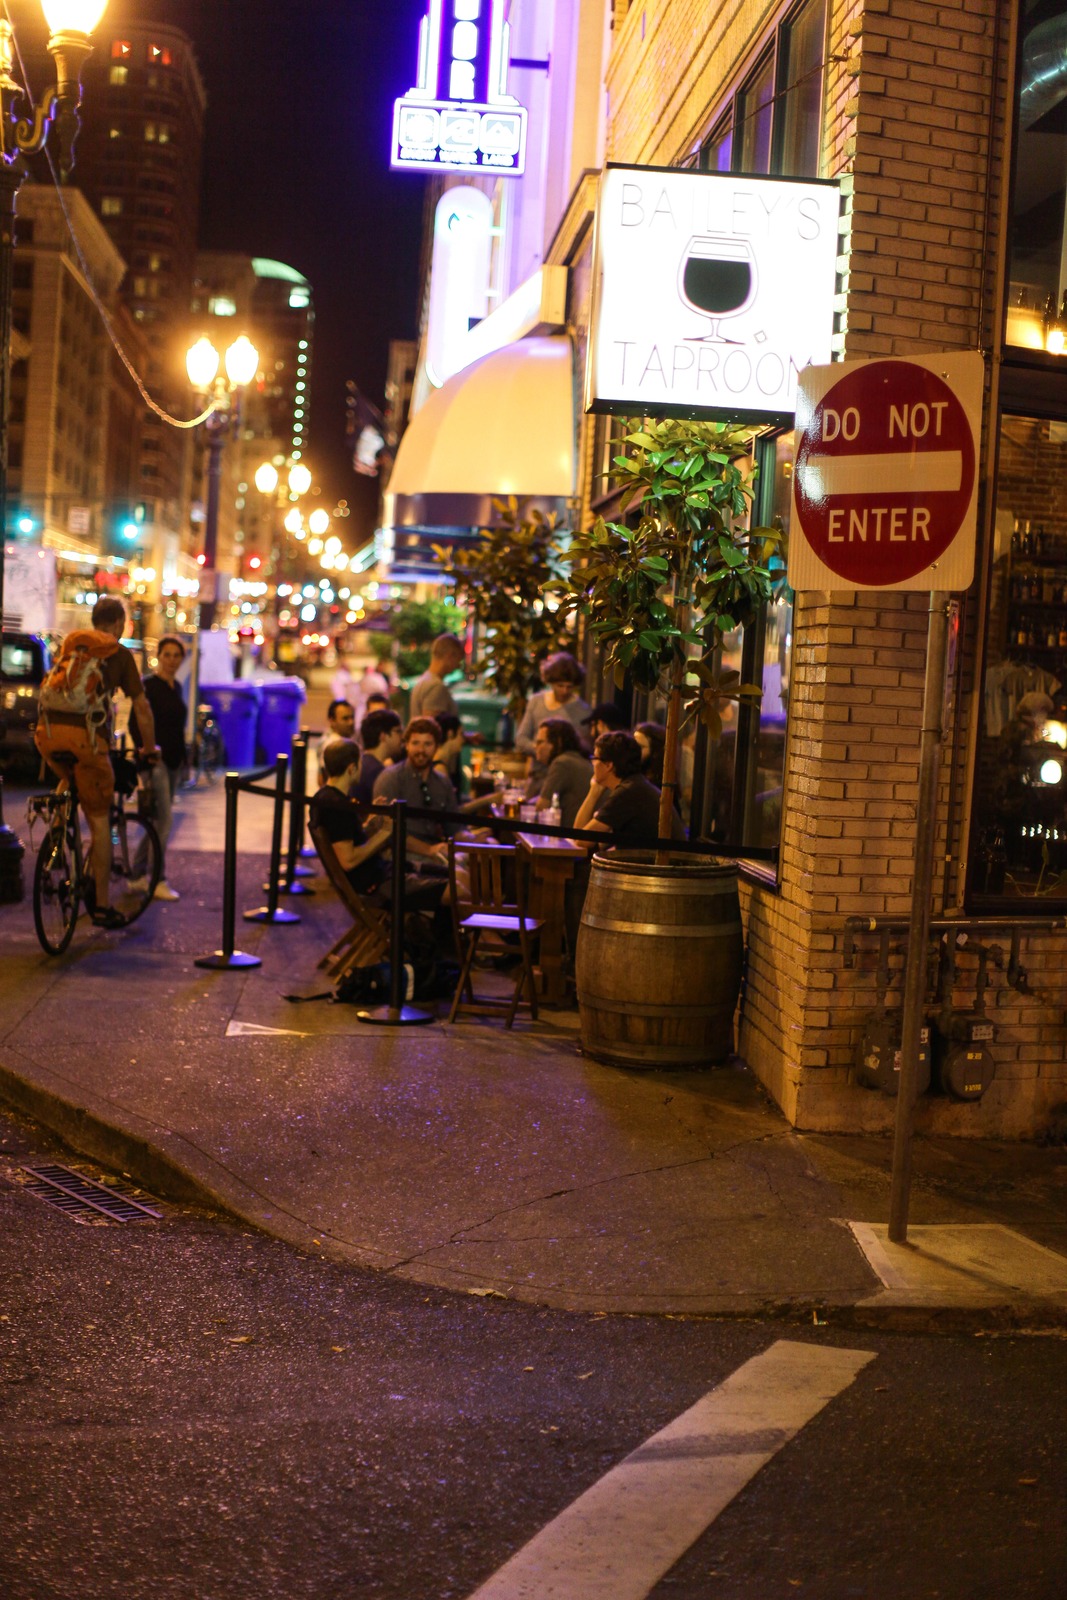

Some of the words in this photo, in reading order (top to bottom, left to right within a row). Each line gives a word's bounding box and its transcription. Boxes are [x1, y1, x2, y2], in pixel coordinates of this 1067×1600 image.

[621, 183, 820, 240] BAILEY'S
[822, 406, 861, 442] DO
[889, 401, 949, 438] NOT
[828, 506, 931, 542] ENTER
